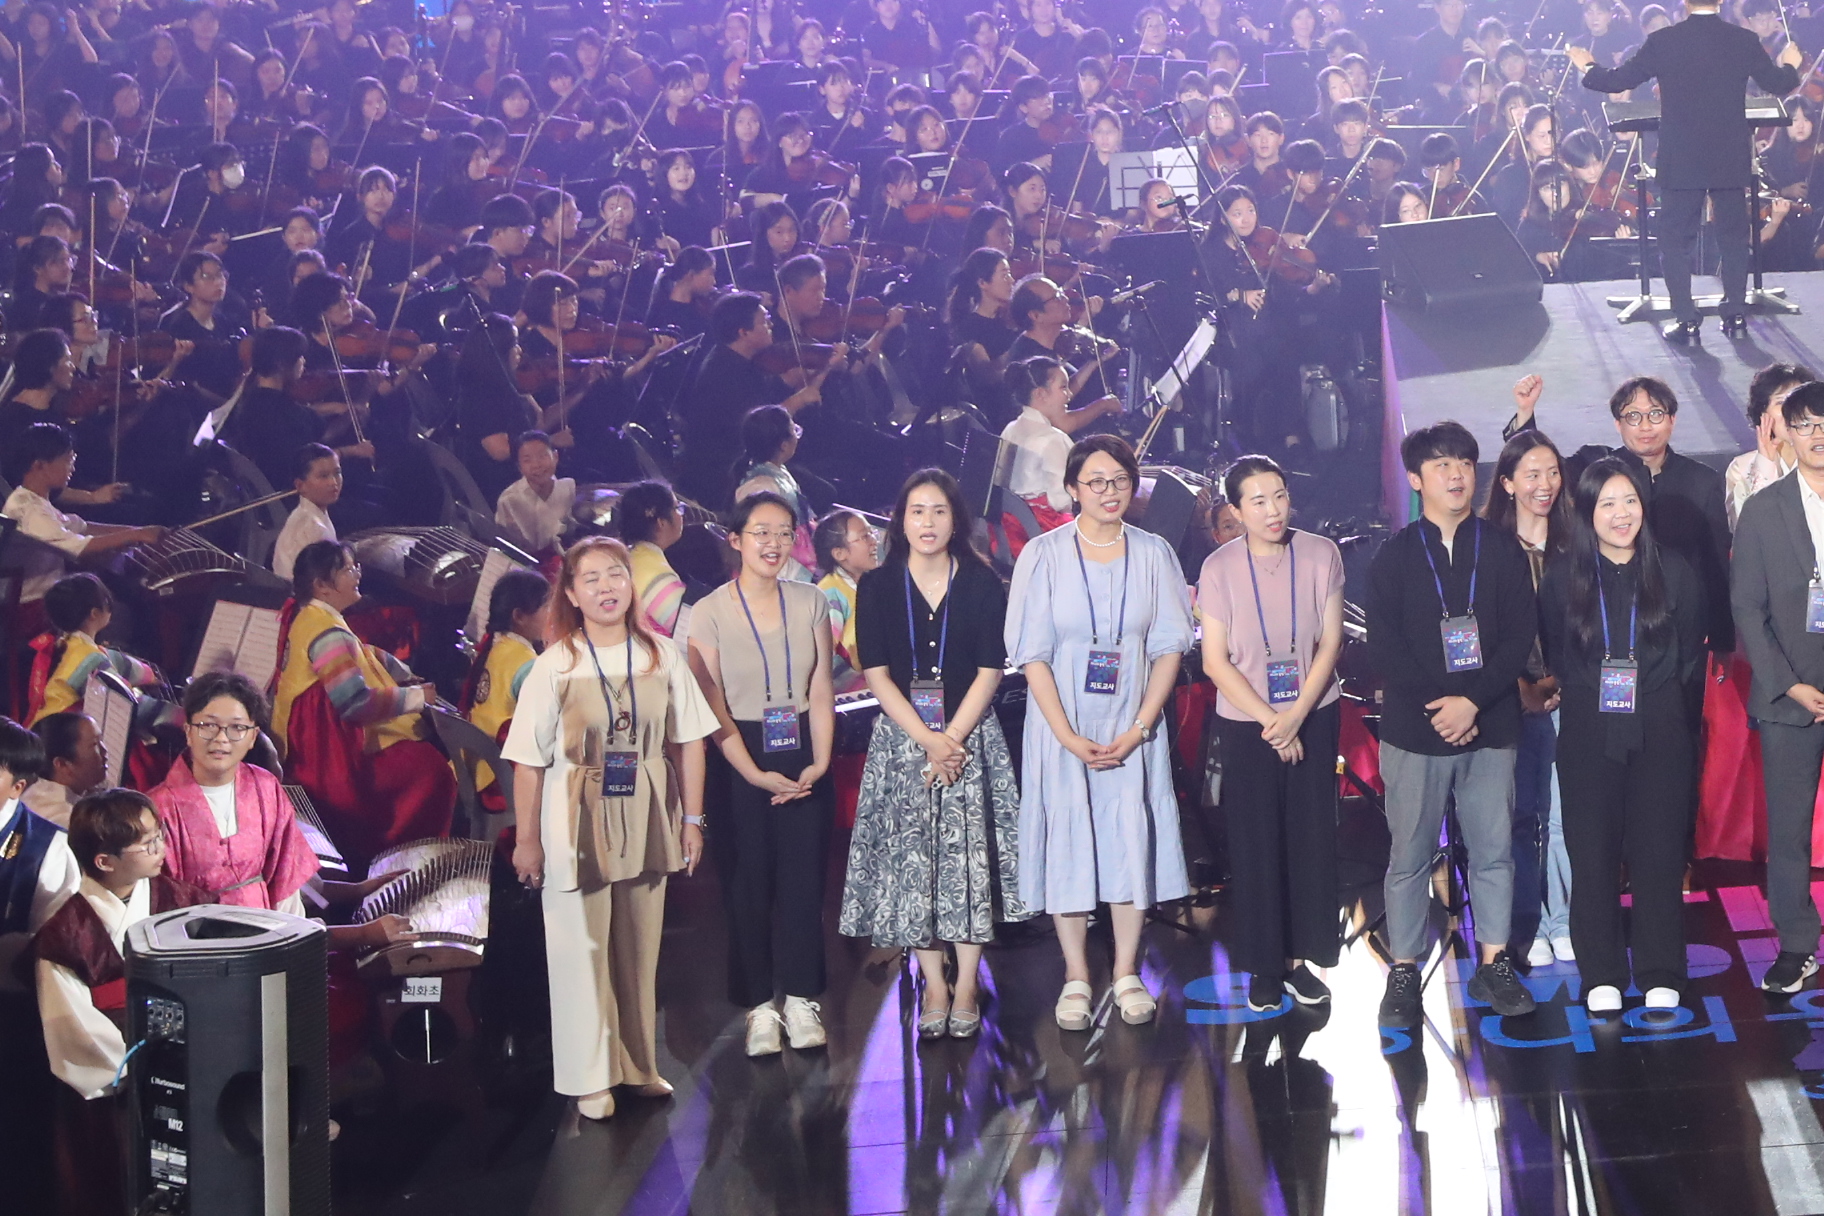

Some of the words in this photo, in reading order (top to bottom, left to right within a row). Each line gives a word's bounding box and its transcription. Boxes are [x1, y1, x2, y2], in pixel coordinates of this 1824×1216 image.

[1454, 656, 1479, 667] 지도교사
[1090, 681, 1115, 691] 지도교사
[1273, 689, 1298, 699] 지도교사
[1606, 700, 1631, 709] 지도교사
[771, 737, 796, 747] 지도교사
[608, 784, 634, 793] 지도교사
